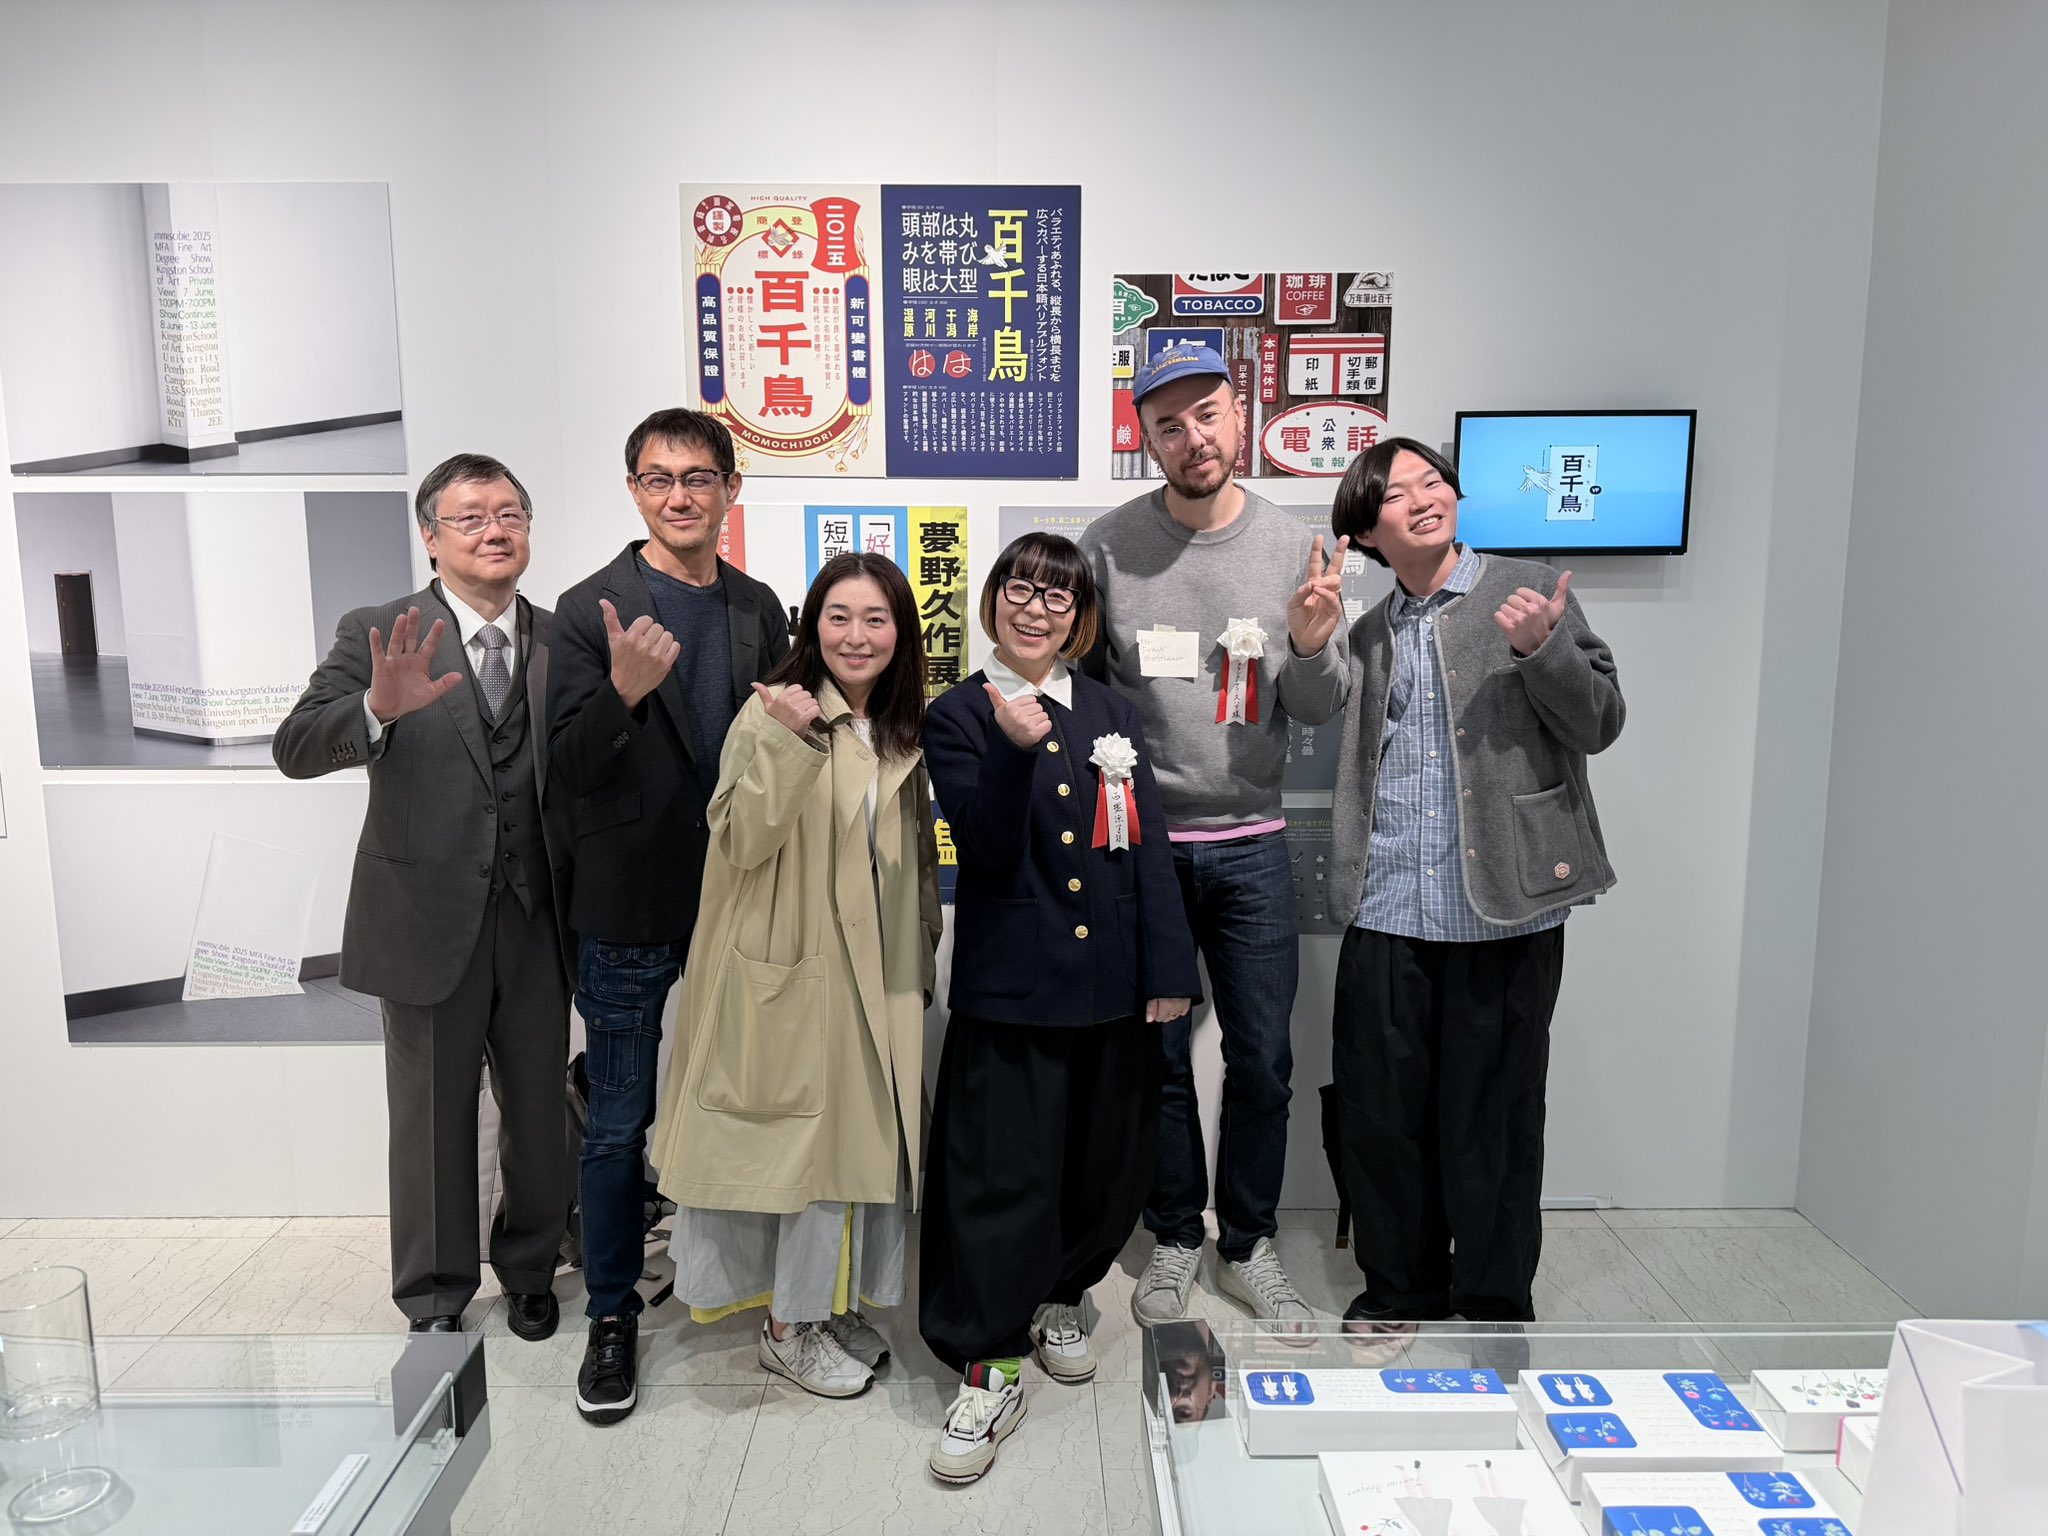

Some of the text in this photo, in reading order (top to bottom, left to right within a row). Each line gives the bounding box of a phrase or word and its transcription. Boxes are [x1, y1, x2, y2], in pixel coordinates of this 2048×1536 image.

[902, 212, 978, 237] 頭部は丸
[193, 231, 211, 240] 2025
[155, 243, 212, 251] MFA Fine Art
[902, 240, 978, 266] みを帯び
[156, 254, 179, 266] Degree
[189, 264, 213, 274] School
[189, 277, 214, 285] Private
[903, 267, 978, 293] 眼は大型
[1286, 274, 1326, 289] 珈琲
[184, 288, 188, 296] 7
[987, 209, 1029, 383] 百千鳥
[1286, 291, 1324, 300] COFFEE
[1182, 300, 1255, 310] TOBACCO
[160, 320, 165, 329] 8
[200, 321, 217, 329] June
[903, 308, 914, 337] 湿原
[925, 308, 936, 337] 河川
[967, 308, 978, 337] 海岸
[193, 331, 217, 340] School
[162, 343, 169, 351] of
[186, 343, 218, 353] Kingston
[754, 270, 813, 418] 百千鳥
[163, 353, 219, 363] University
[943, 354, 973, 374] は
[200, 363, 219, 373] Road
[1262, 338, 1275, 398] 本日定休日
[1305, 357, 1319, 390] 印紙
[1346, 357, 1361, 390] 切手類
[1364, 356, 1378, 390] 郵便
[201, 375, 220, 384] Floor
[190, 397, 221, 408] Kingston
[167, 410, 184, 419] upon
[741, 430, 833, 449] MOMOCHIDORI
[1321, 419, 1336, 450] 公衆
[1311, 457, 1345, 468] 電報
[1558, 455, 1585, 513] 百千鳥
[202, 698, 223, 707] Show
[265, 696, 270, 704] 8
[272, 695, 289, 704] June
[204, 708, 243, 717] University
[202, 718, 235, 729] Kingston
[239, 718, 257, 727] upon
